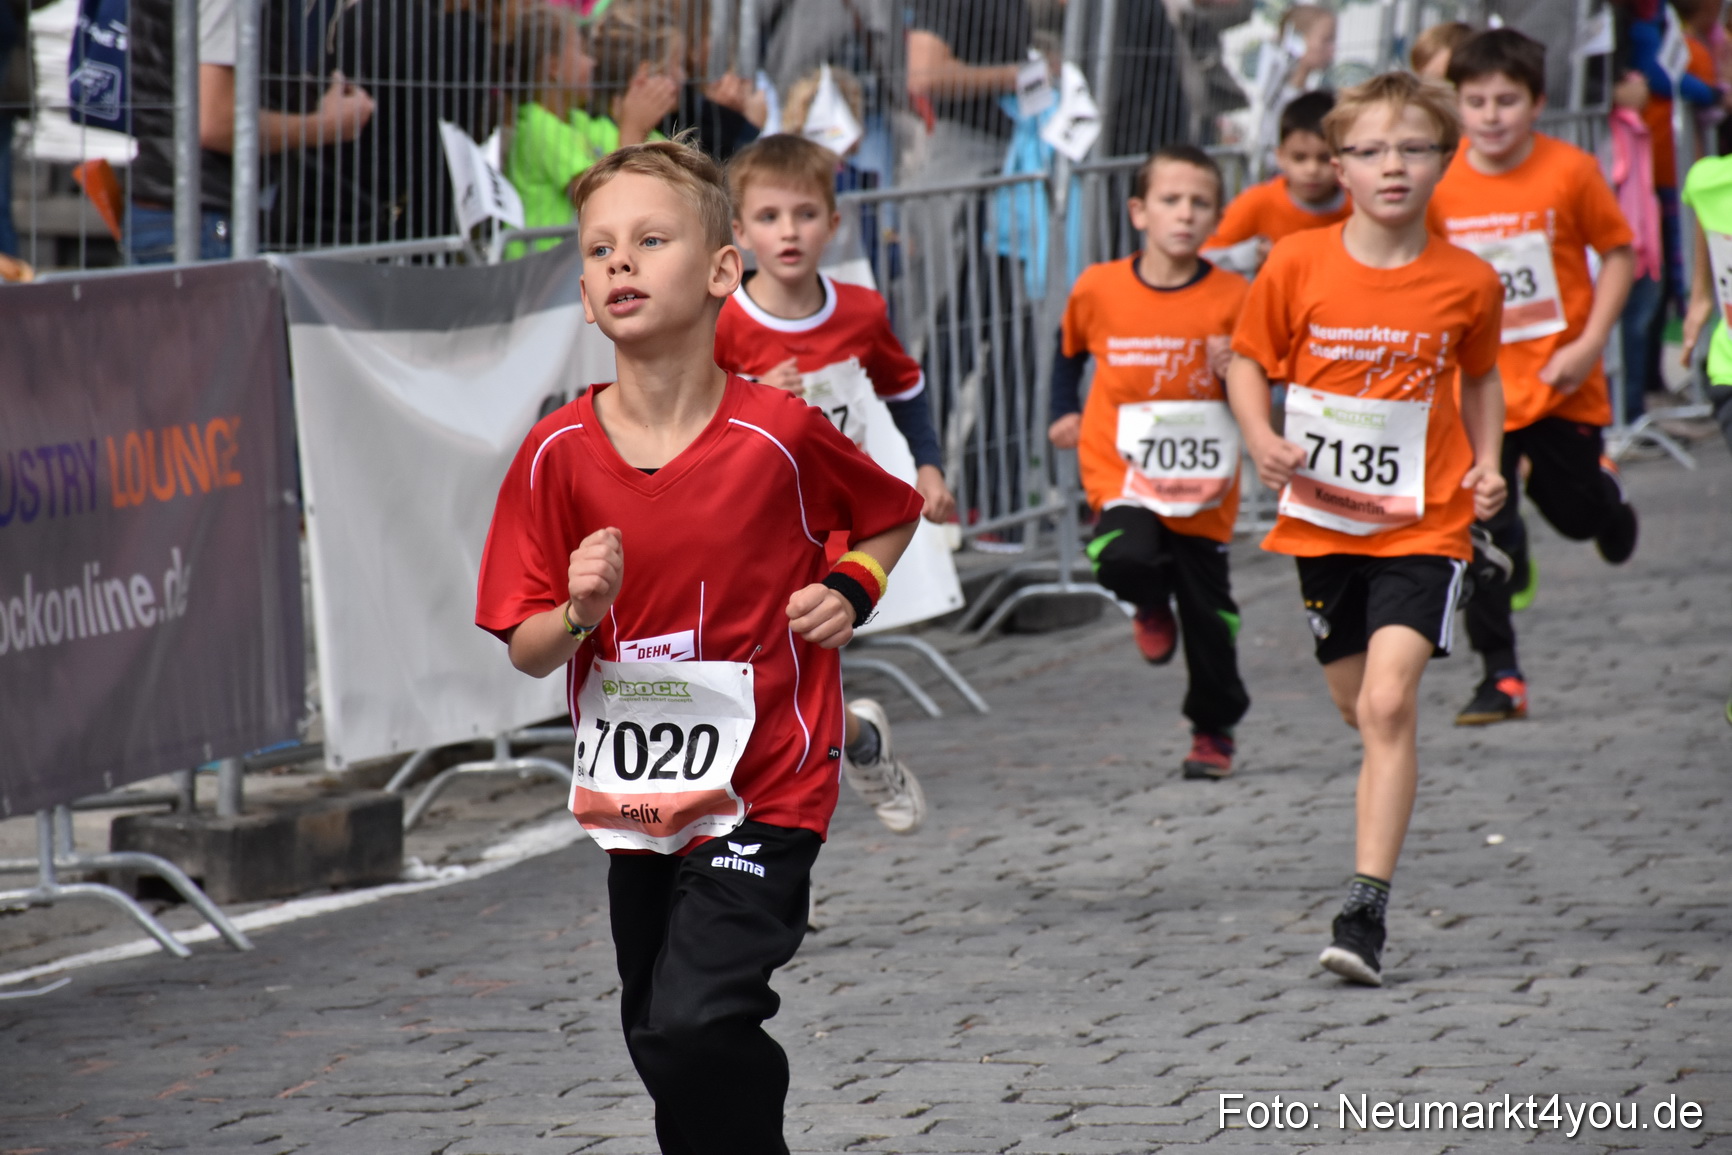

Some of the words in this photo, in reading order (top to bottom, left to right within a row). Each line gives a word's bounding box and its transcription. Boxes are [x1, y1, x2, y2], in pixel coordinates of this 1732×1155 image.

[1309, 322, 1409, 343] Neumarkter
[1309, 341, 1387, 364] Stadtlauf
[1138, 437, 1220, 470] 7035
[1305, 431, 1399, 485] 7135
[1315, 486, 1385, 515] Konstantin
[638, 643, 672, 660] DEHN
[619, 680, 691, 698] BOCK
[589, 717, 720, 781] 7020
[620, 803, 662, 824] Felix
[711, 854, 765, 878] erima
